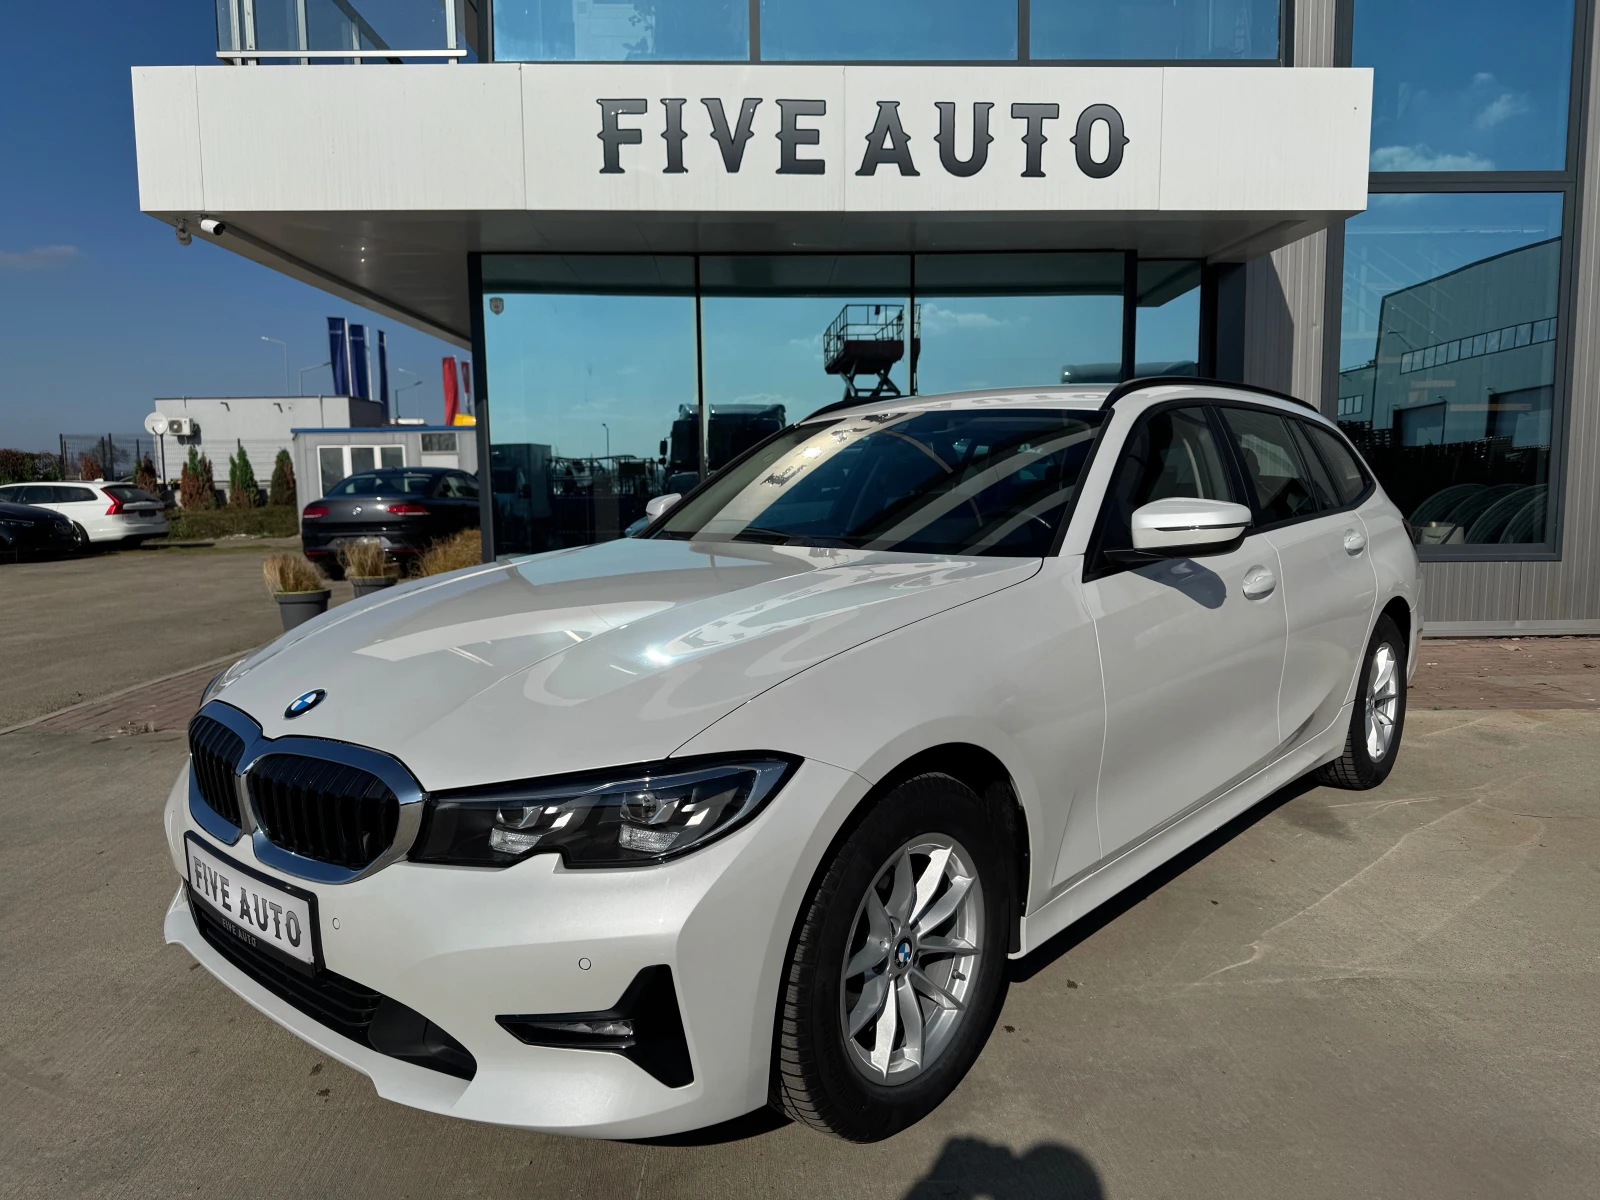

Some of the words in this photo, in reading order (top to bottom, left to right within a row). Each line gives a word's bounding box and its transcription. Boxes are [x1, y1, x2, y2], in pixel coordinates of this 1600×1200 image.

[596, 98, 827, 175] FIVE
[855, 100, 1130, 178] AUTO
[193, 856, 232, 912] FIVE
[239, 887, 302, 948] AUTO
[222, 918, 237, 935] FIVE
[239, 929, 257, 947] AUTO
